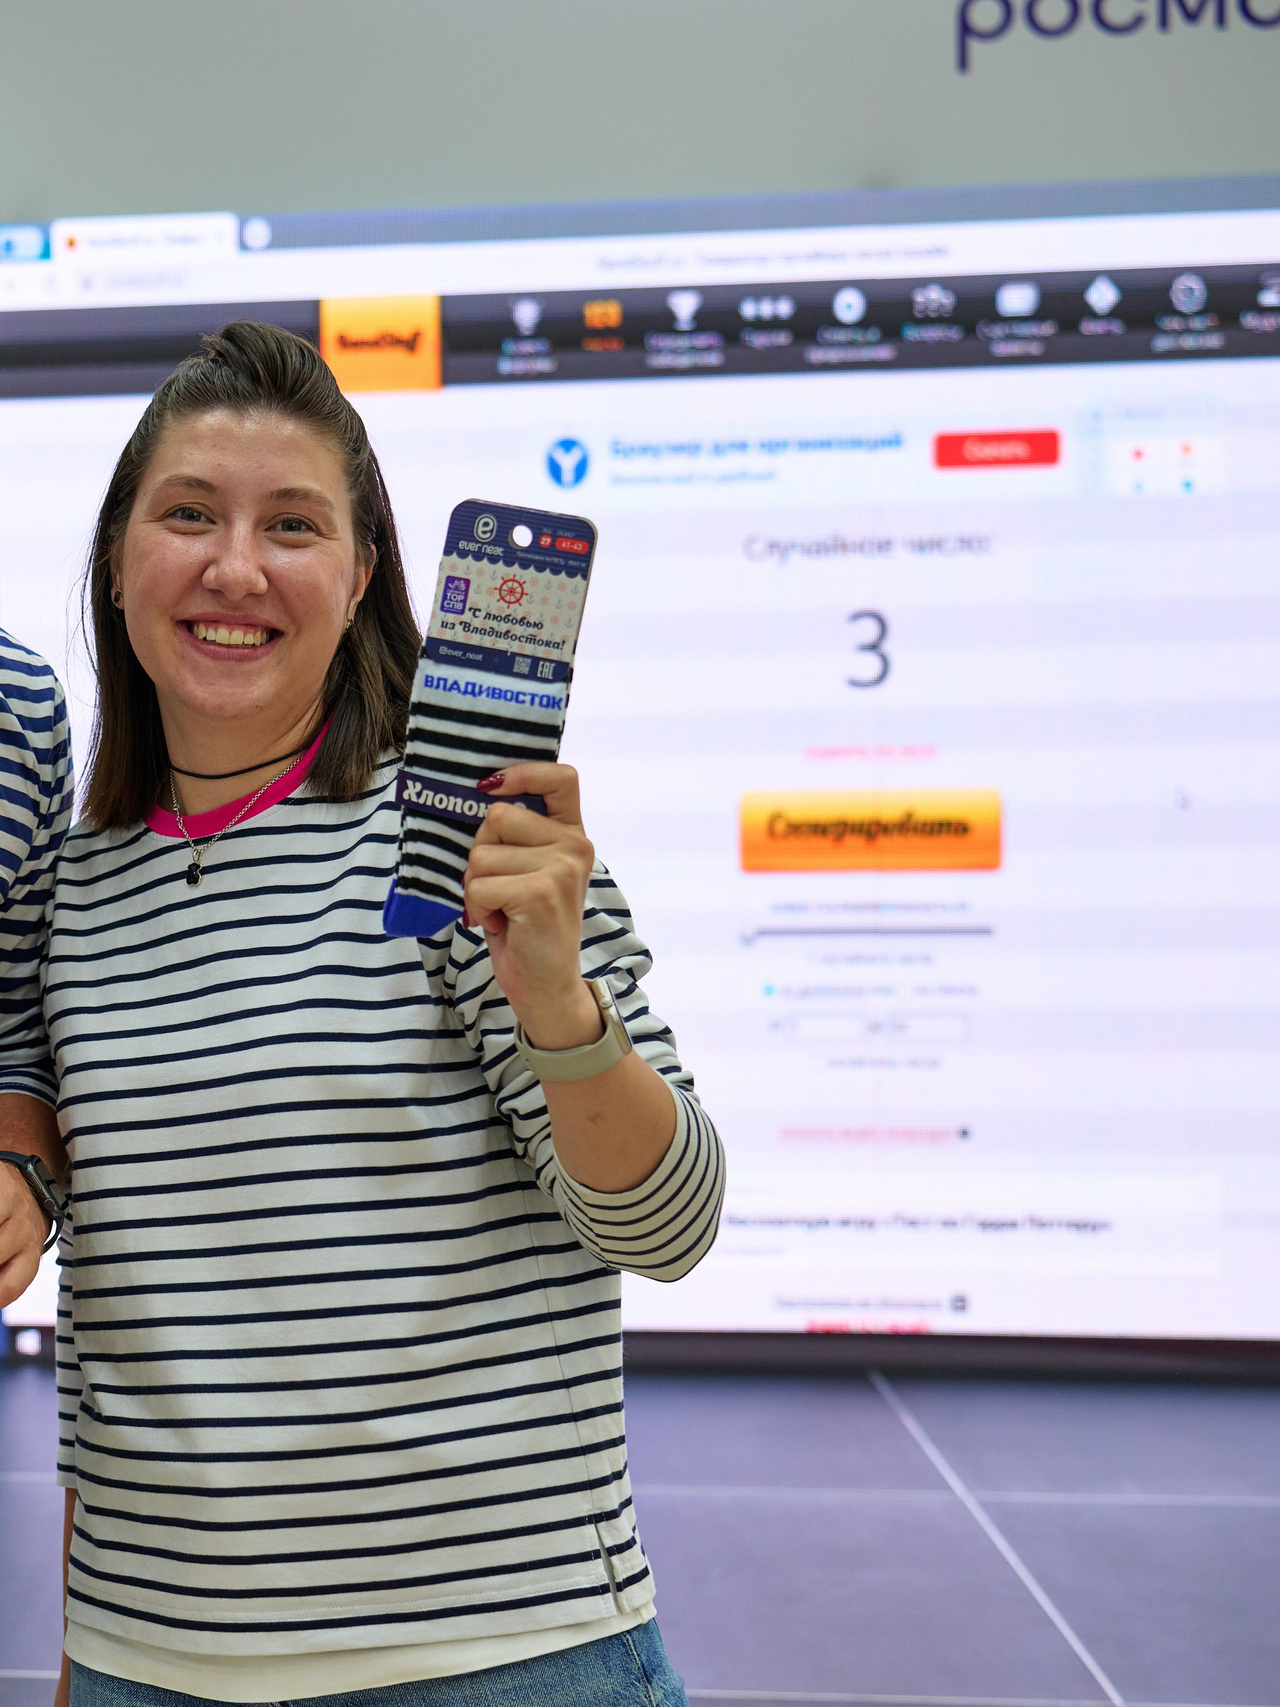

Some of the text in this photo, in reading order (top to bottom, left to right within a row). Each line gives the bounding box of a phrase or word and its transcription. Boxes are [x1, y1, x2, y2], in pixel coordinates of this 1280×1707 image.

[458, 540, 504, 557] ever neat
[540, 537, 583, 551] 27 41-43
[443, 600, 463, 610] СПВ
[483, 612, 544, 630] любовью
[440, 620, 566, 650] из Владивостока!
[438, 645, 483, 661] @ever_neat
[846, 609, 891, 688] 3
[423, 674, 564, 711] ВЛАДИВОСТОК
